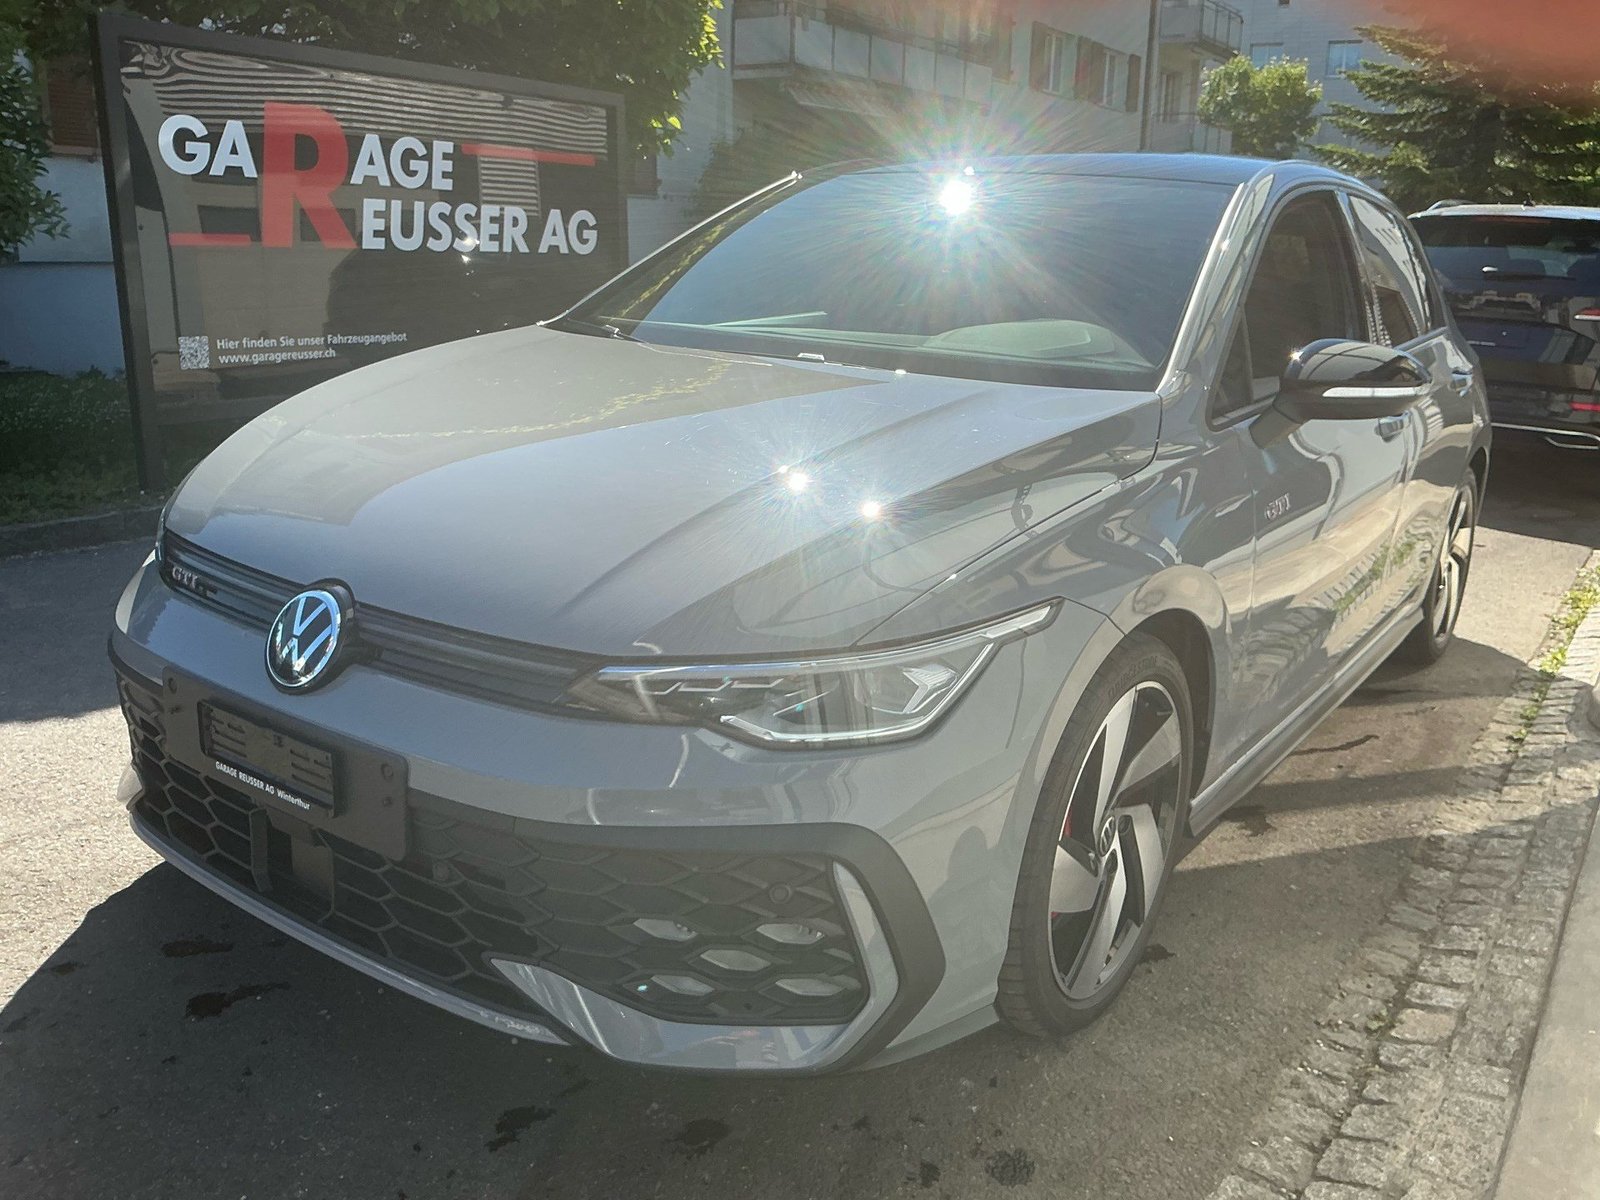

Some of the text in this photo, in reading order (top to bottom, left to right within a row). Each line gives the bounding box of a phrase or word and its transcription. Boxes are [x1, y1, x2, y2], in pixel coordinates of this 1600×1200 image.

[158, 101, 454, 248] GARAGE
[538, 209, 598, 255] AG
[216, 331, 408, 350] Hier finden Sie unser Fahrzeugangebot
[218, 348, 336, 364] www.garagereusser.ch
[1264, 492, 1290, 520] GTI
[171, 565, 199, 591] GTI
[215, 760, 311, 810] GARAGE REUSSER AG Winterthur
